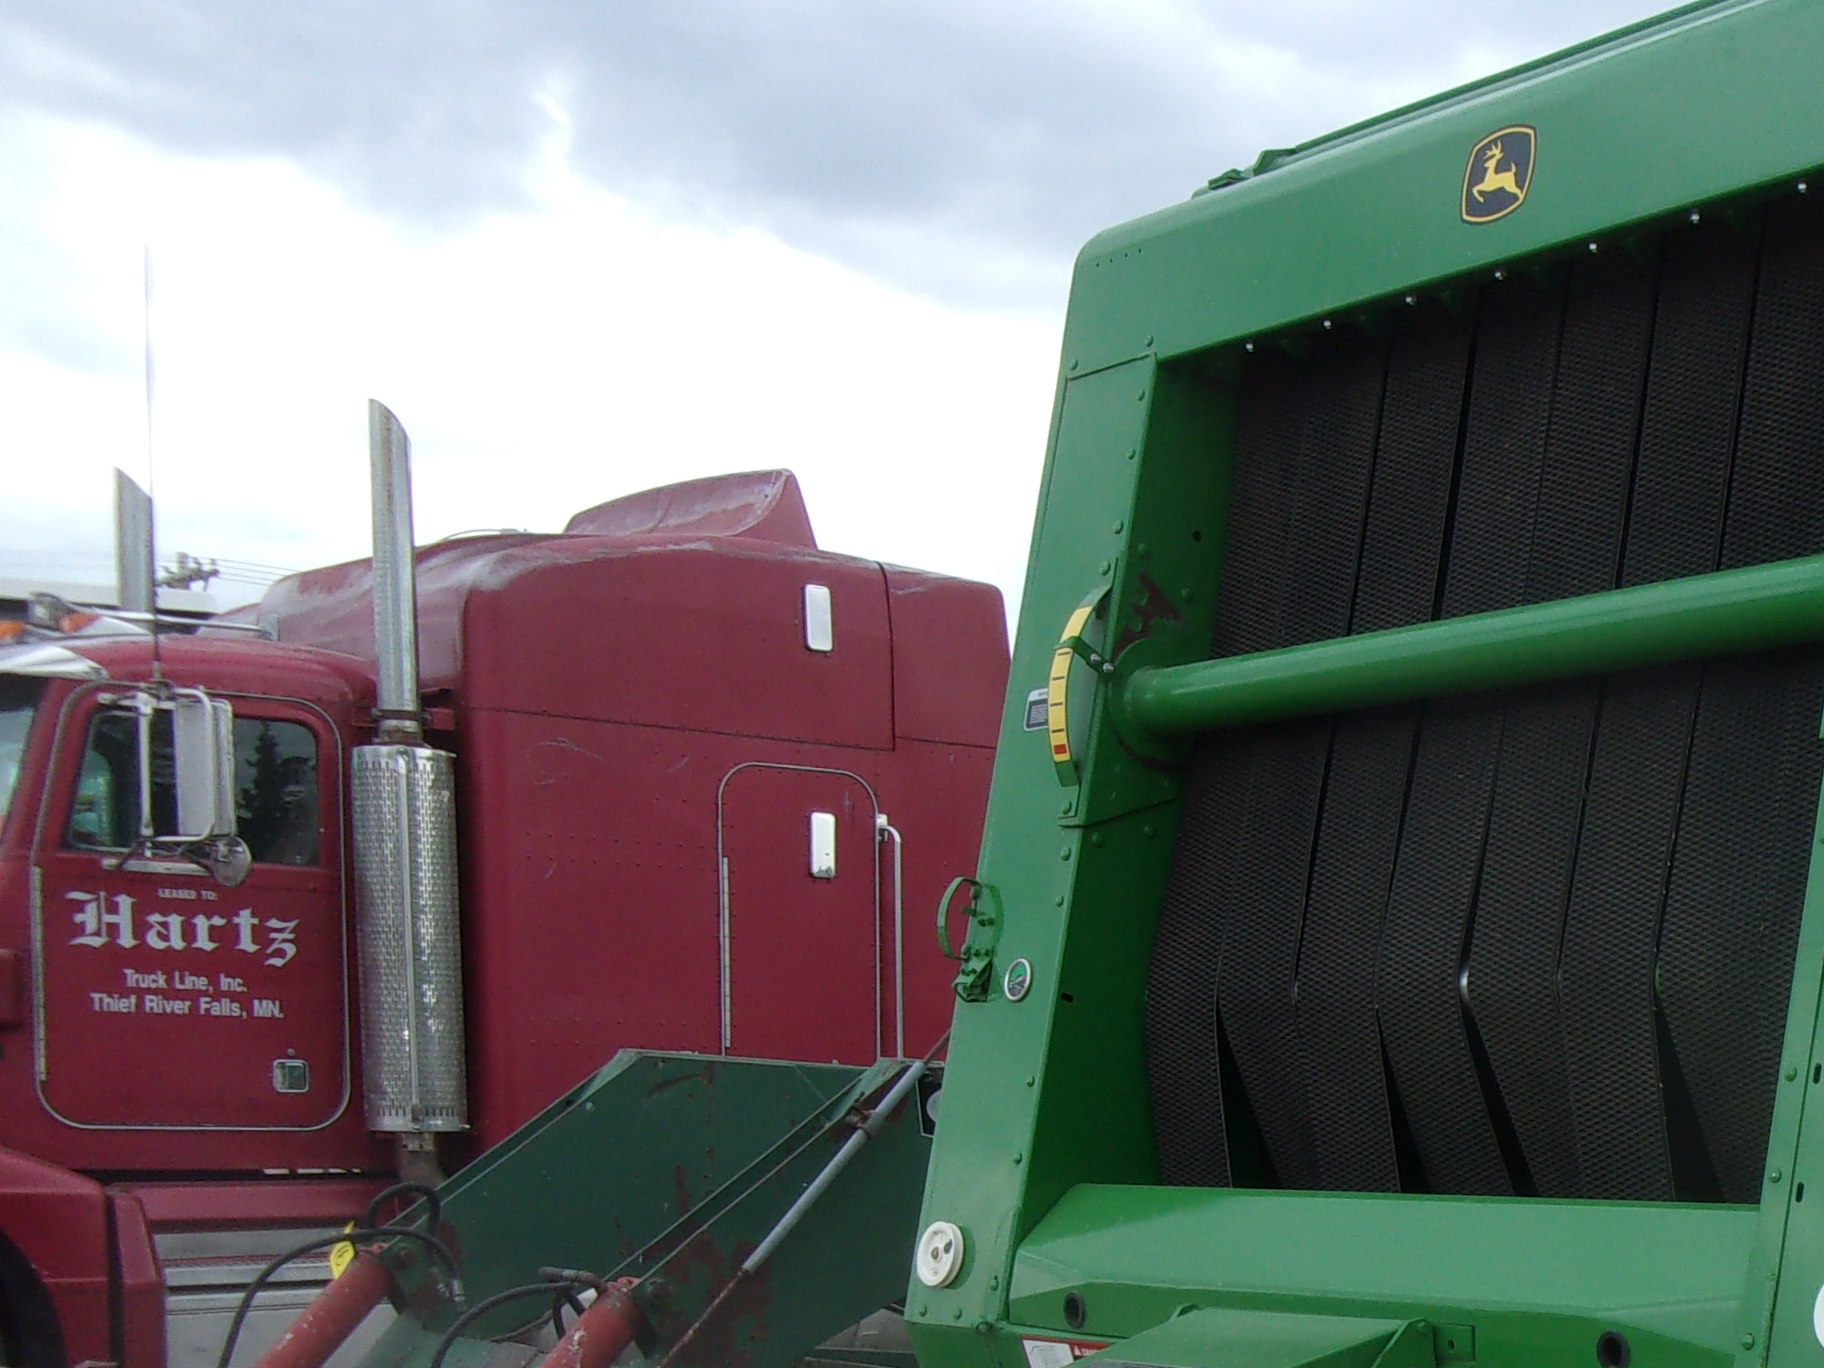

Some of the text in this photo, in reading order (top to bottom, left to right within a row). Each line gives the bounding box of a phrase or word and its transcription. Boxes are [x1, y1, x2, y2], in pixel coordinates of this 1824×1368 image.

[157, 888, 218, 900] LEASED TO:
[65, 890, 299, 968] Hartz
[123, 969, 248, 993] Truck Line, Inc.
[89, 993, 284, 1019] Thief River Falls, MN.
